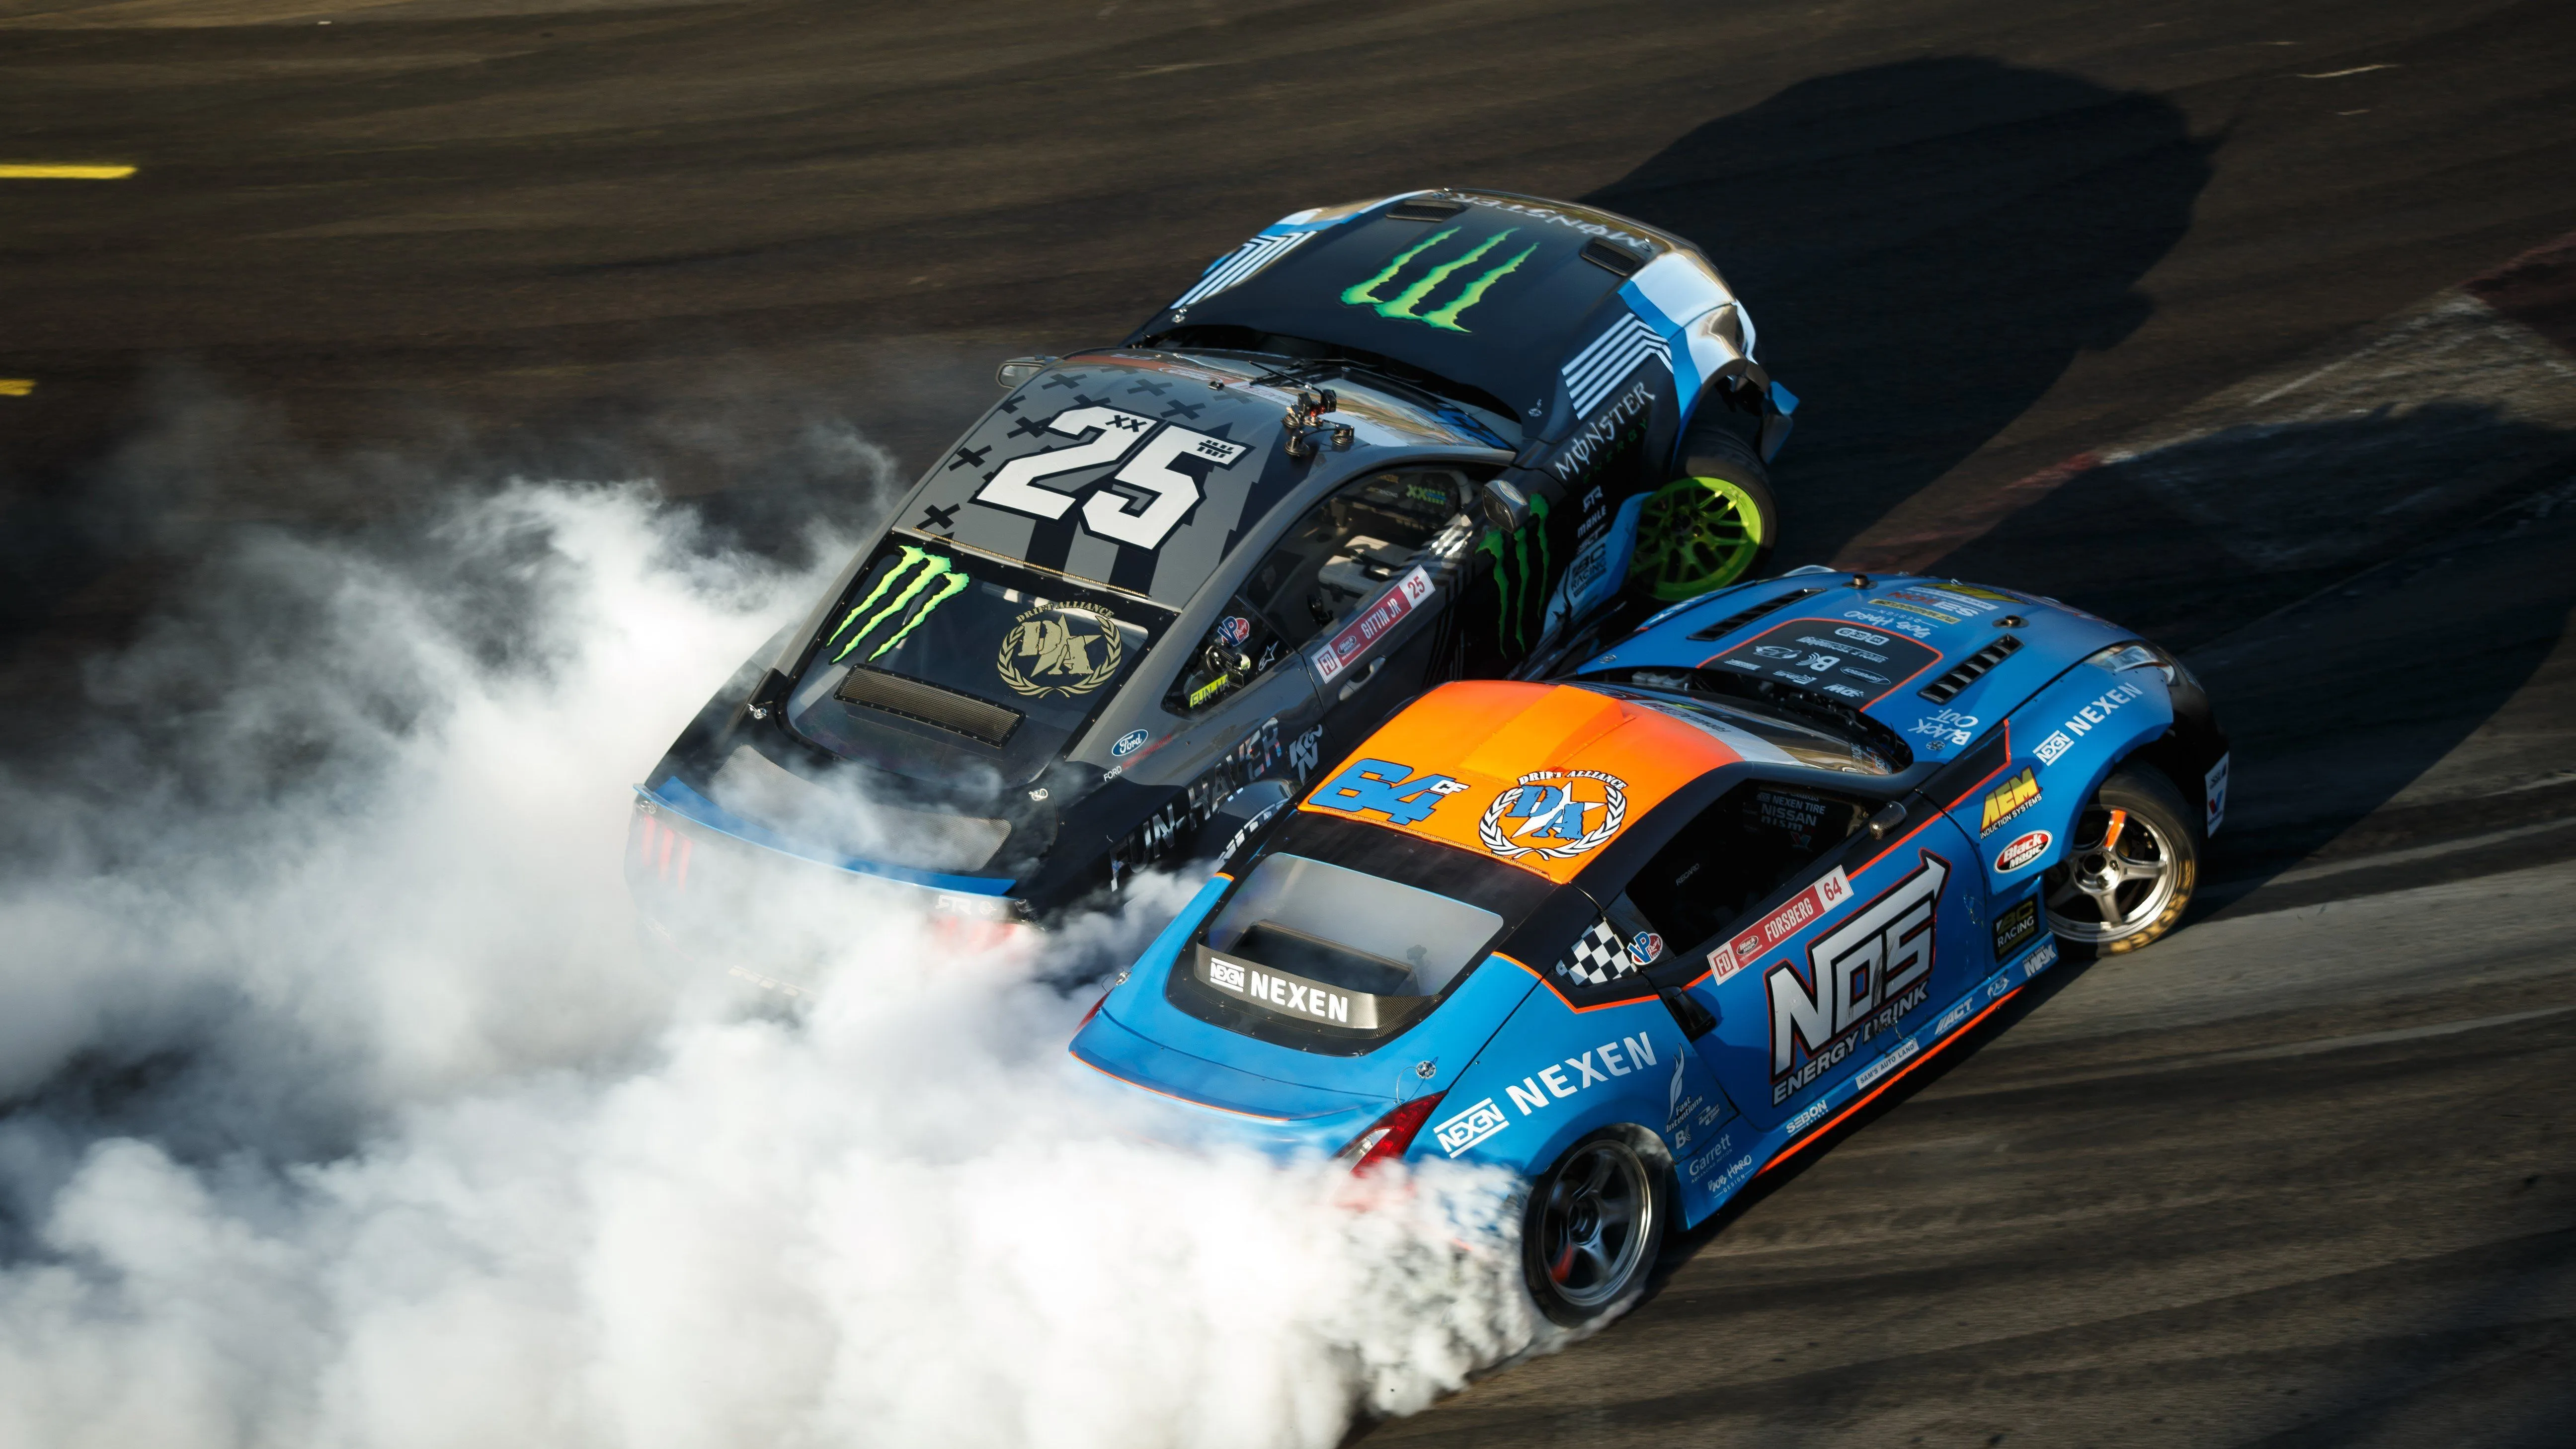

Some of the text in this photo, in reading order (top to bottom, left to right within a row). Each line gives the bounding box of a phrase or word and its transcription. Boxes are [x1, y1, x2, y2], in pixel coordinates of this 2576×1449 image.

[976, 406, 1246, 550] 25
[1407, 575, 1426, 599] 25
[1016, 601, 1115, 623] DRIFT ALLIANCE
[1361, 597, 1402, 640] GITTIN JR
[1217, 616, 1240, 646] VP
[2065, 682, 2144, 737] NEXEN
[1118, 733, 1144, 754] Ford
[1908, 719, 1971, 745] BLACK
[1103, 765, 1123, 782] FORD
[1517, 770, 1629, 791] DRIFT ALLIANCE
[1772, 795, 1803, 810] NEXEN
[1805, 802, 1826, 815] TIRE
[1981, 766, 2039, 831] AEM
[1761, 803, 1817, 827] NISSAN
[1980, 794, 2043, 840] INDUCTION SYSTEMS
[2003, 833, 2044, 861] Black
[2009, 844, 2043, 869] Magic
[1676, 862, 1700, 886] RECARO
[1824, 877, 1843, 901] 64
[1765, 897, 1814, 942] FORSBERG
[1998, 916, 2034, 948] RACING
[1627, 931, 1653, 964] VP
[2023, 944, 2057, 978] MAX
[1716, 953, 1730, 975] FD
[1770, 856, 1946, 1077] NOS
[1251, 970, 1348, 1023] NEXEN
[1505, 1031, 1658, 1116] NEXEN
[1773, 1030, 1859, 1106] ENERGY
[1859, 1042, 1915, 1084] SAM'S AUTO LAND
[1666, 1095, 1703, 1133] Intentions
[1676, 1096, 1691, 1117] Fast
[1786, 1100, 1828, 1133] SEIBON
[1690, 1133, 1731, 1176] Garrett
